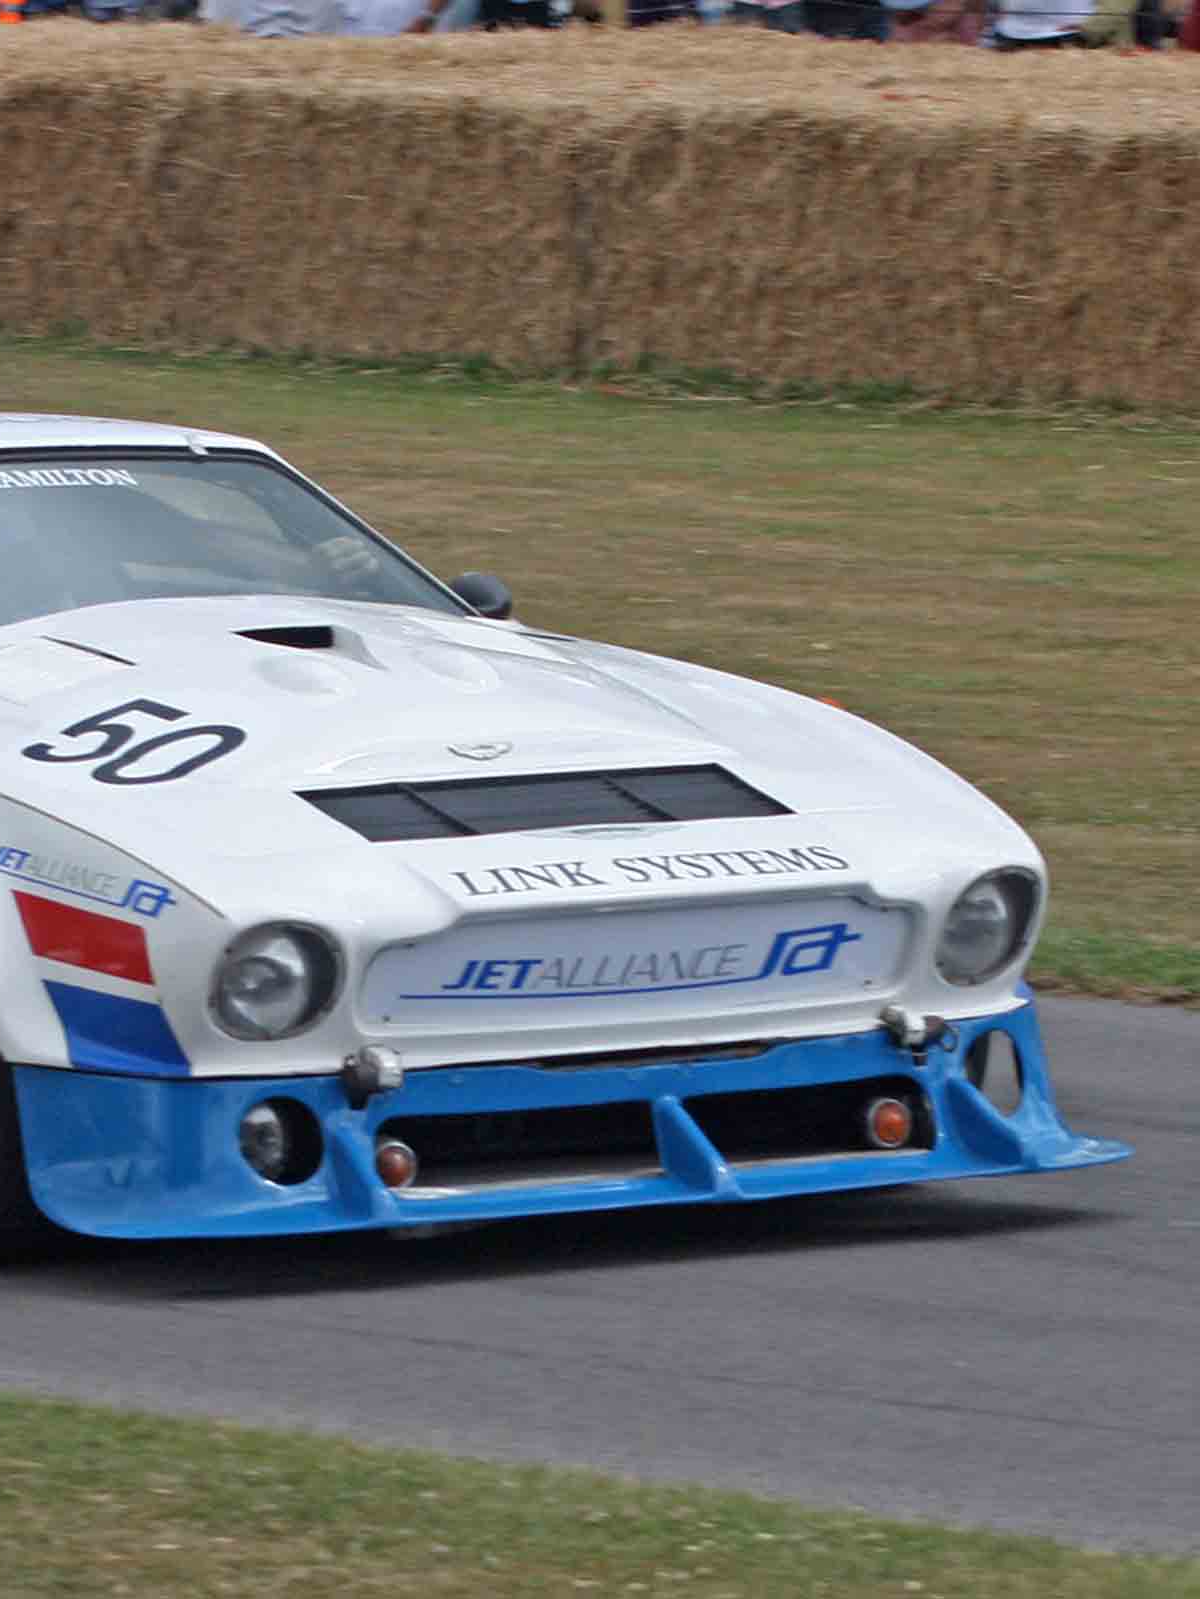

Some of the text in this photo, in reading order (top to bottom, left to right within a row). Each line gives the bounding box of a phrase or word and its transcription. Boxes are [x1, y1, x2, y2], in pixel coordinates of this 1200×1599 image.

[20, 698, 246, 785] 50
[453, 845, 850, 897] LINK SYSTEMS
